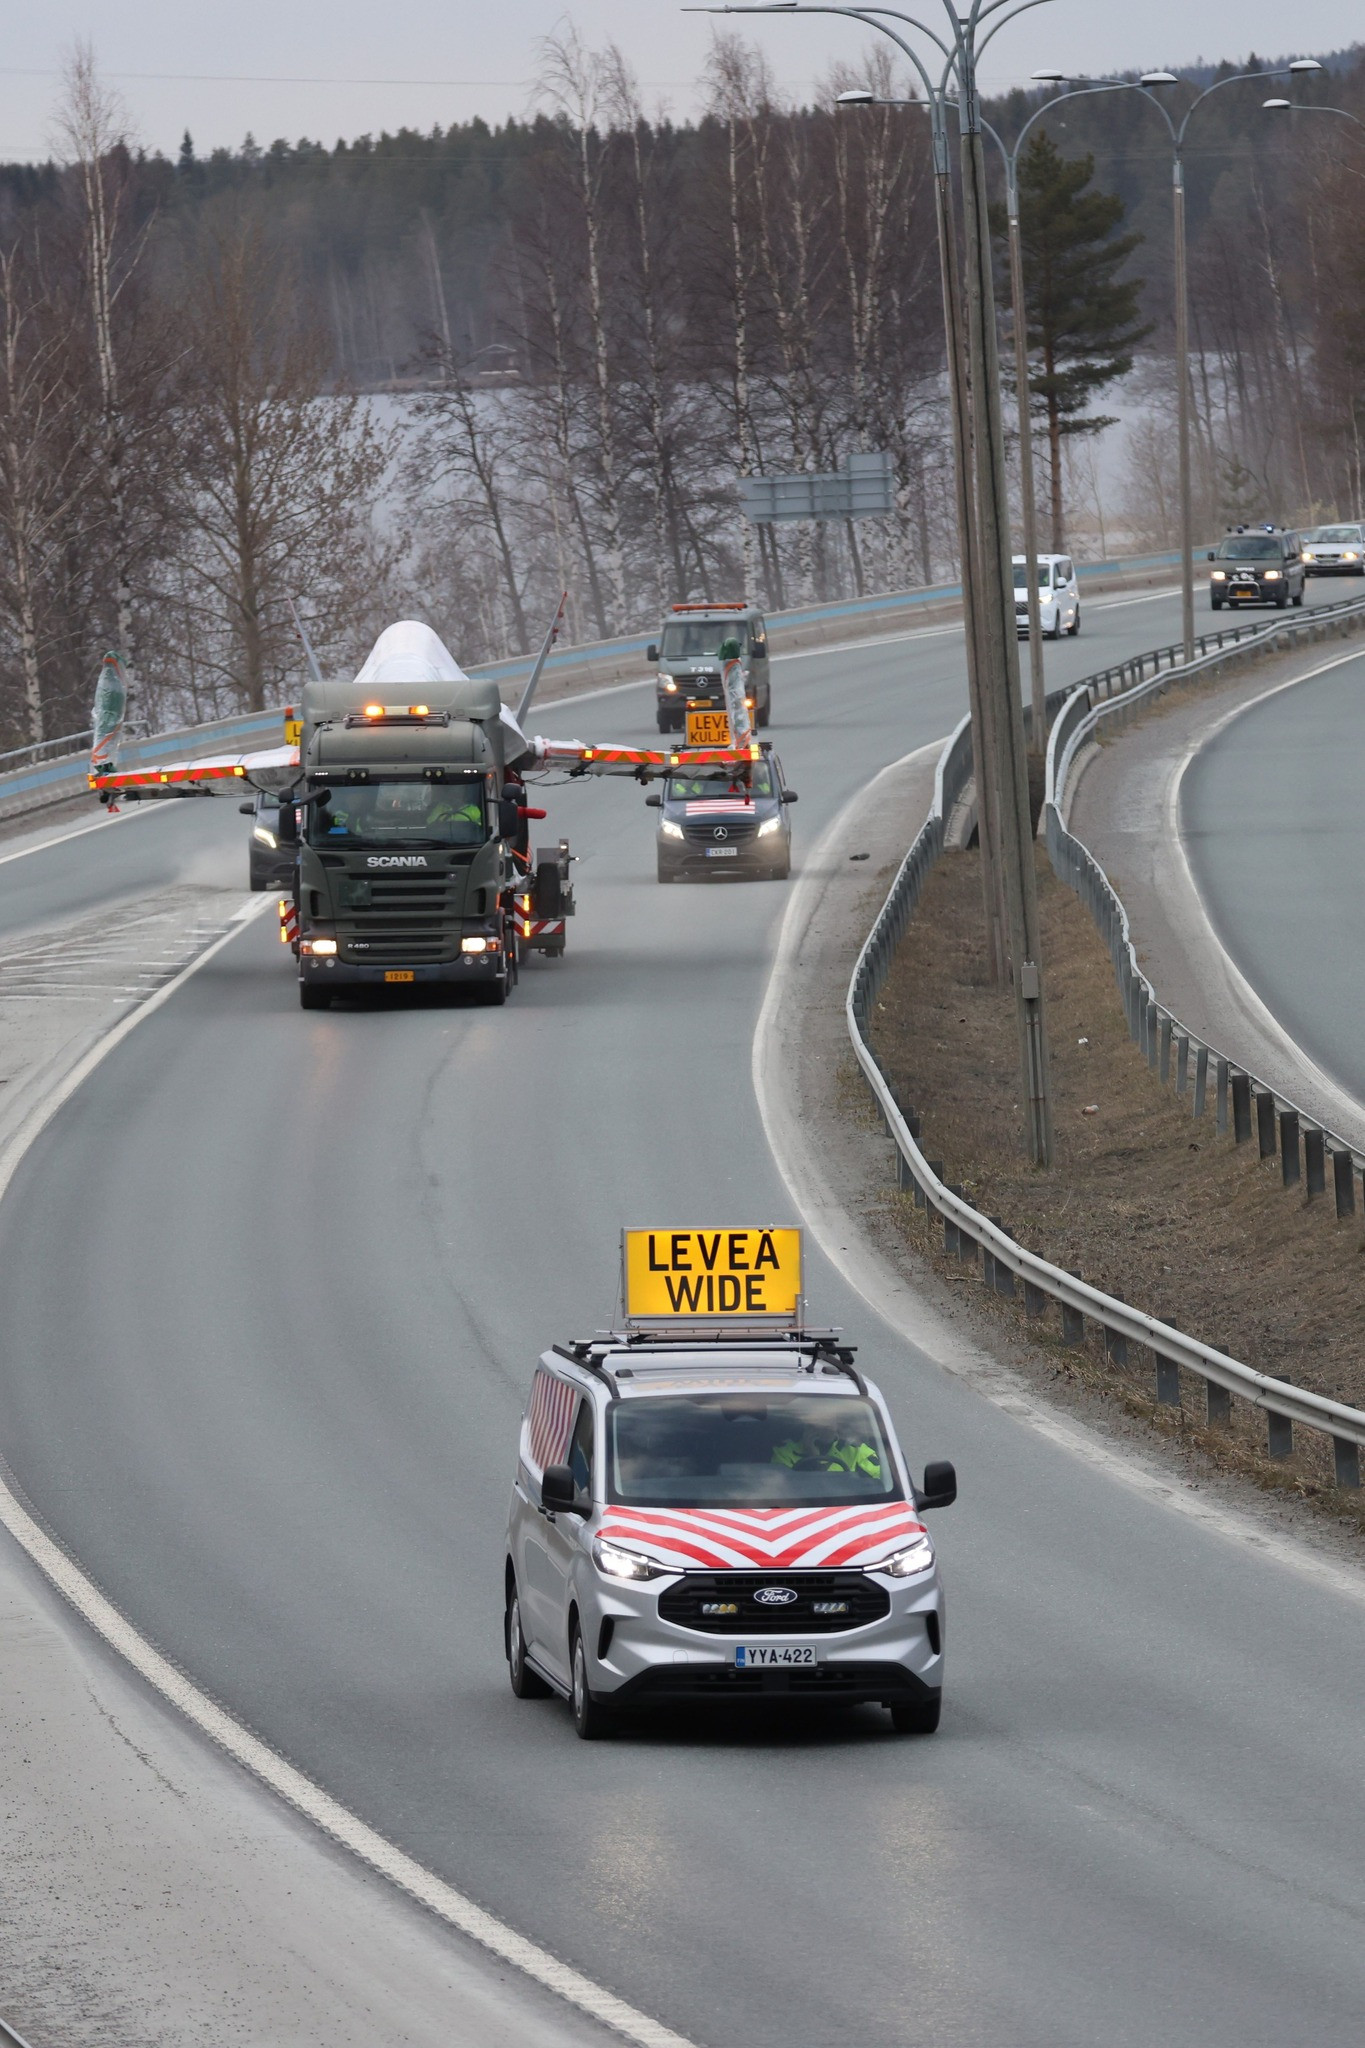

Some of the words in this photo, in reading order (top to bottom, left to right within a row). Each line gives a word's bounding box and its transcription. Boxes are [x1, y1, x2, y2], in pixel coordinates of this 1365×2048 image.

[695, 715, 729, 730] LEVE
[690, 730, 730, 743] KULJE
[366, 856, 428, 868] SCANIA
[390, 973, 409, 981] 1219
[648, 1229, 781, 1272] LEVEÄ
[664, 1274, 767, 1313] WIDE
[761, 1589, 790, 1602] Ford
[748, 1648, 813, 1664] YYA-422
